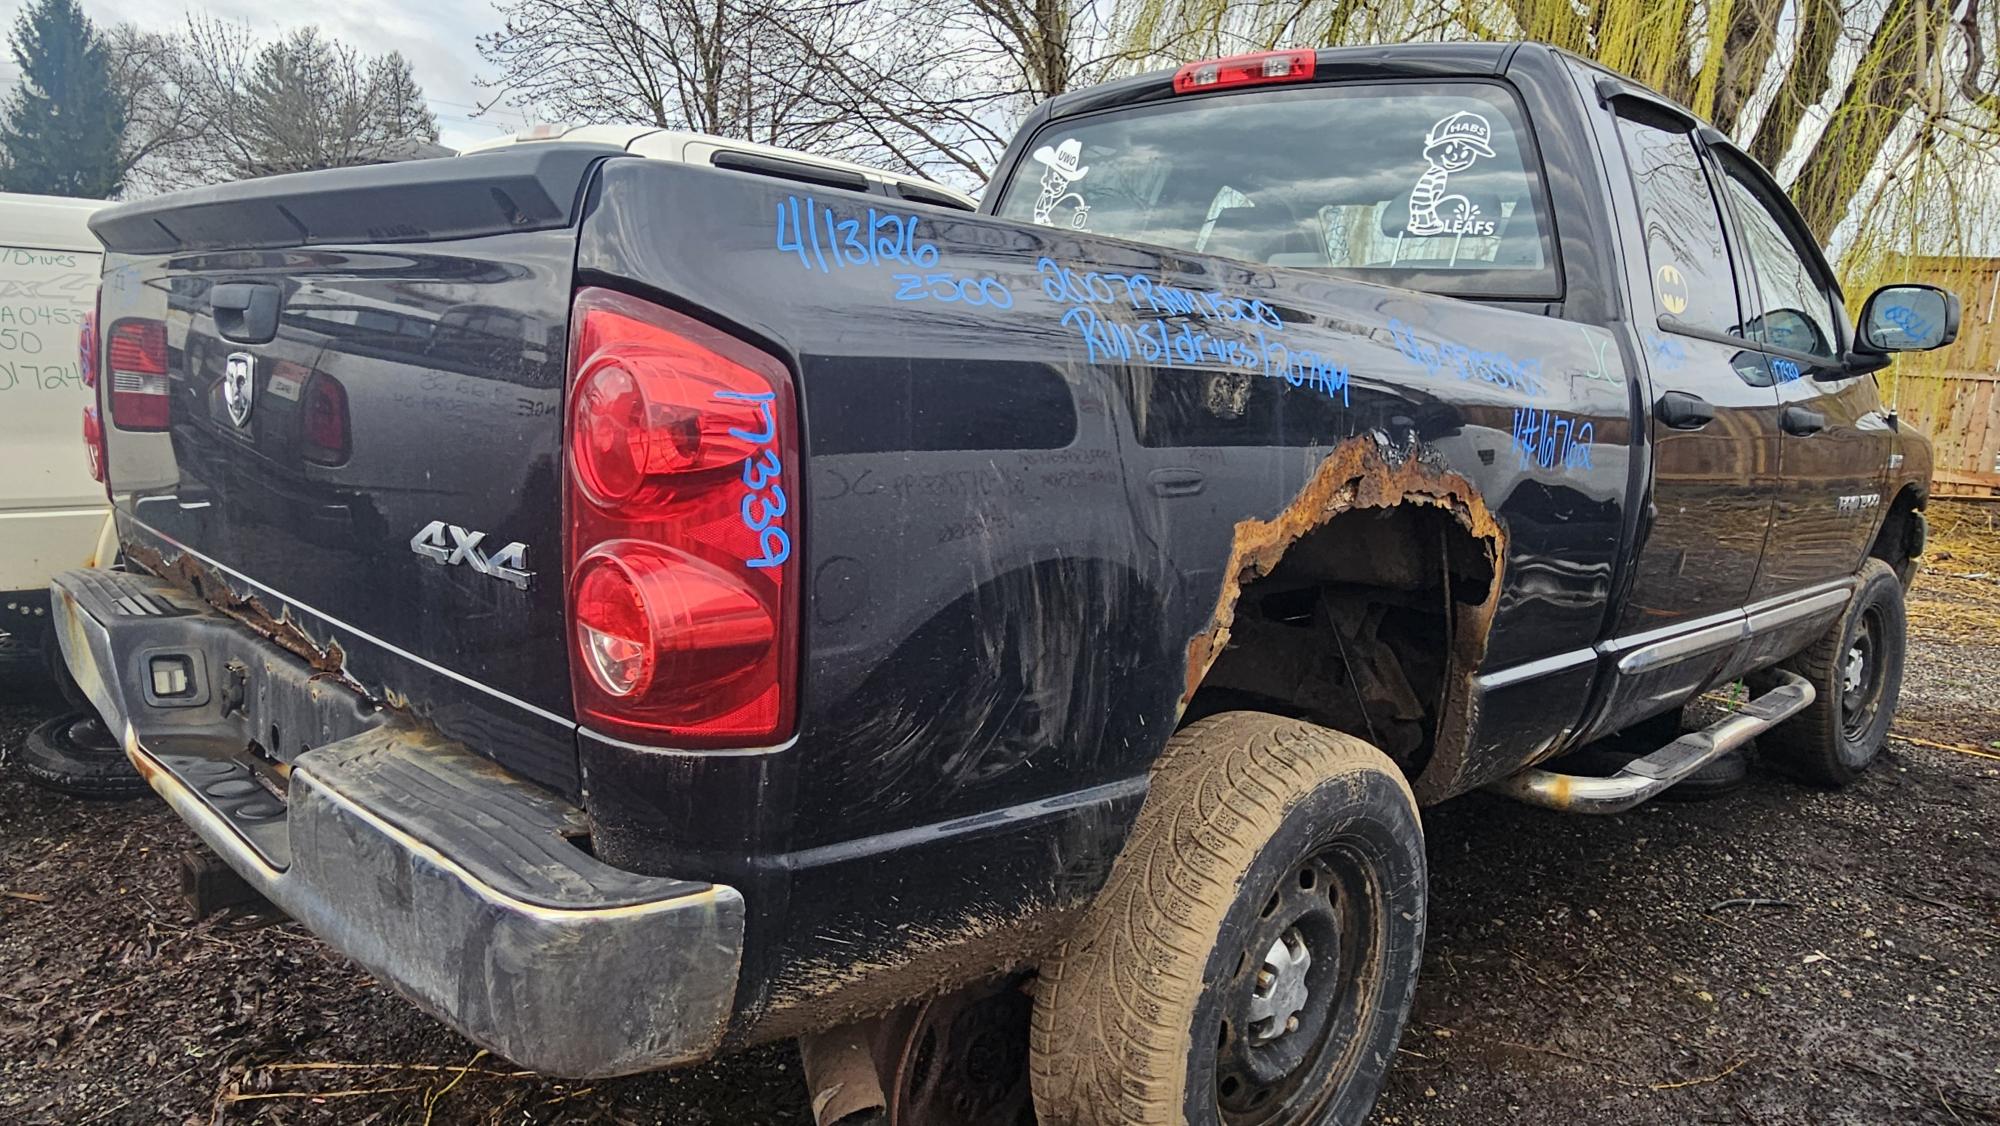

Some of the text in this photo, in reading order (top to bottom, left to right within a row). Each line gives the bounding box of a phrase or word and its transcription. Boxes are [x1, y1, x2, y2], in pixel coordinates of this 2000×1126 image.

[1450, 123, 1486, 136] HABS
[1058, 150, 1076, 166] UWO
[777, 197, 940, 273] 4/13/26
[1443, 219, 1495, 235] LEAFS
[714, 390, 792, 569] 17339
[410, 520, 537, 592] 4X4
